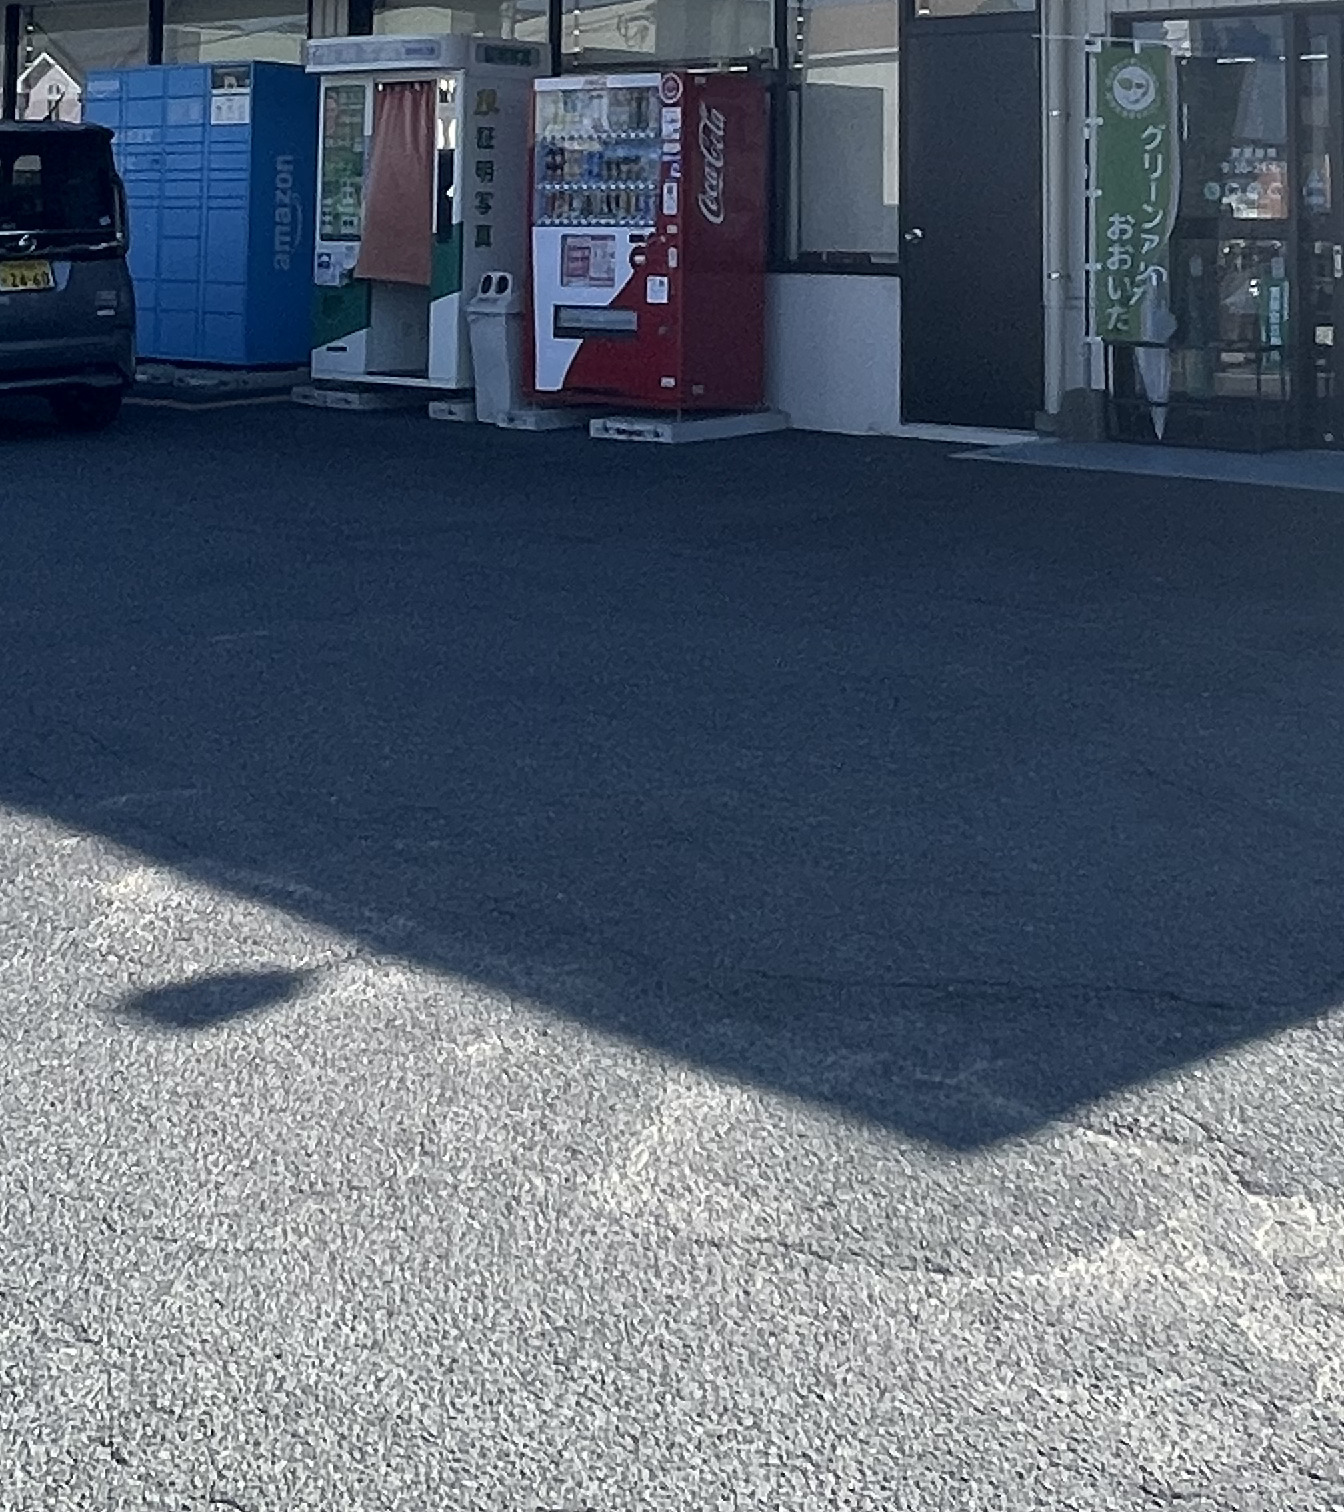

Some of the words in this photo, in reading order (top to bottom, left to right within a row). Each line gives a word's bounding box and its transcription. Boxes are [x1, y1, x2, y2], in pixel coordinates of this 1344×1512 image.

[275, 154, 294, 271] amazon
[1106, 213, 1134, 330] おおいた
